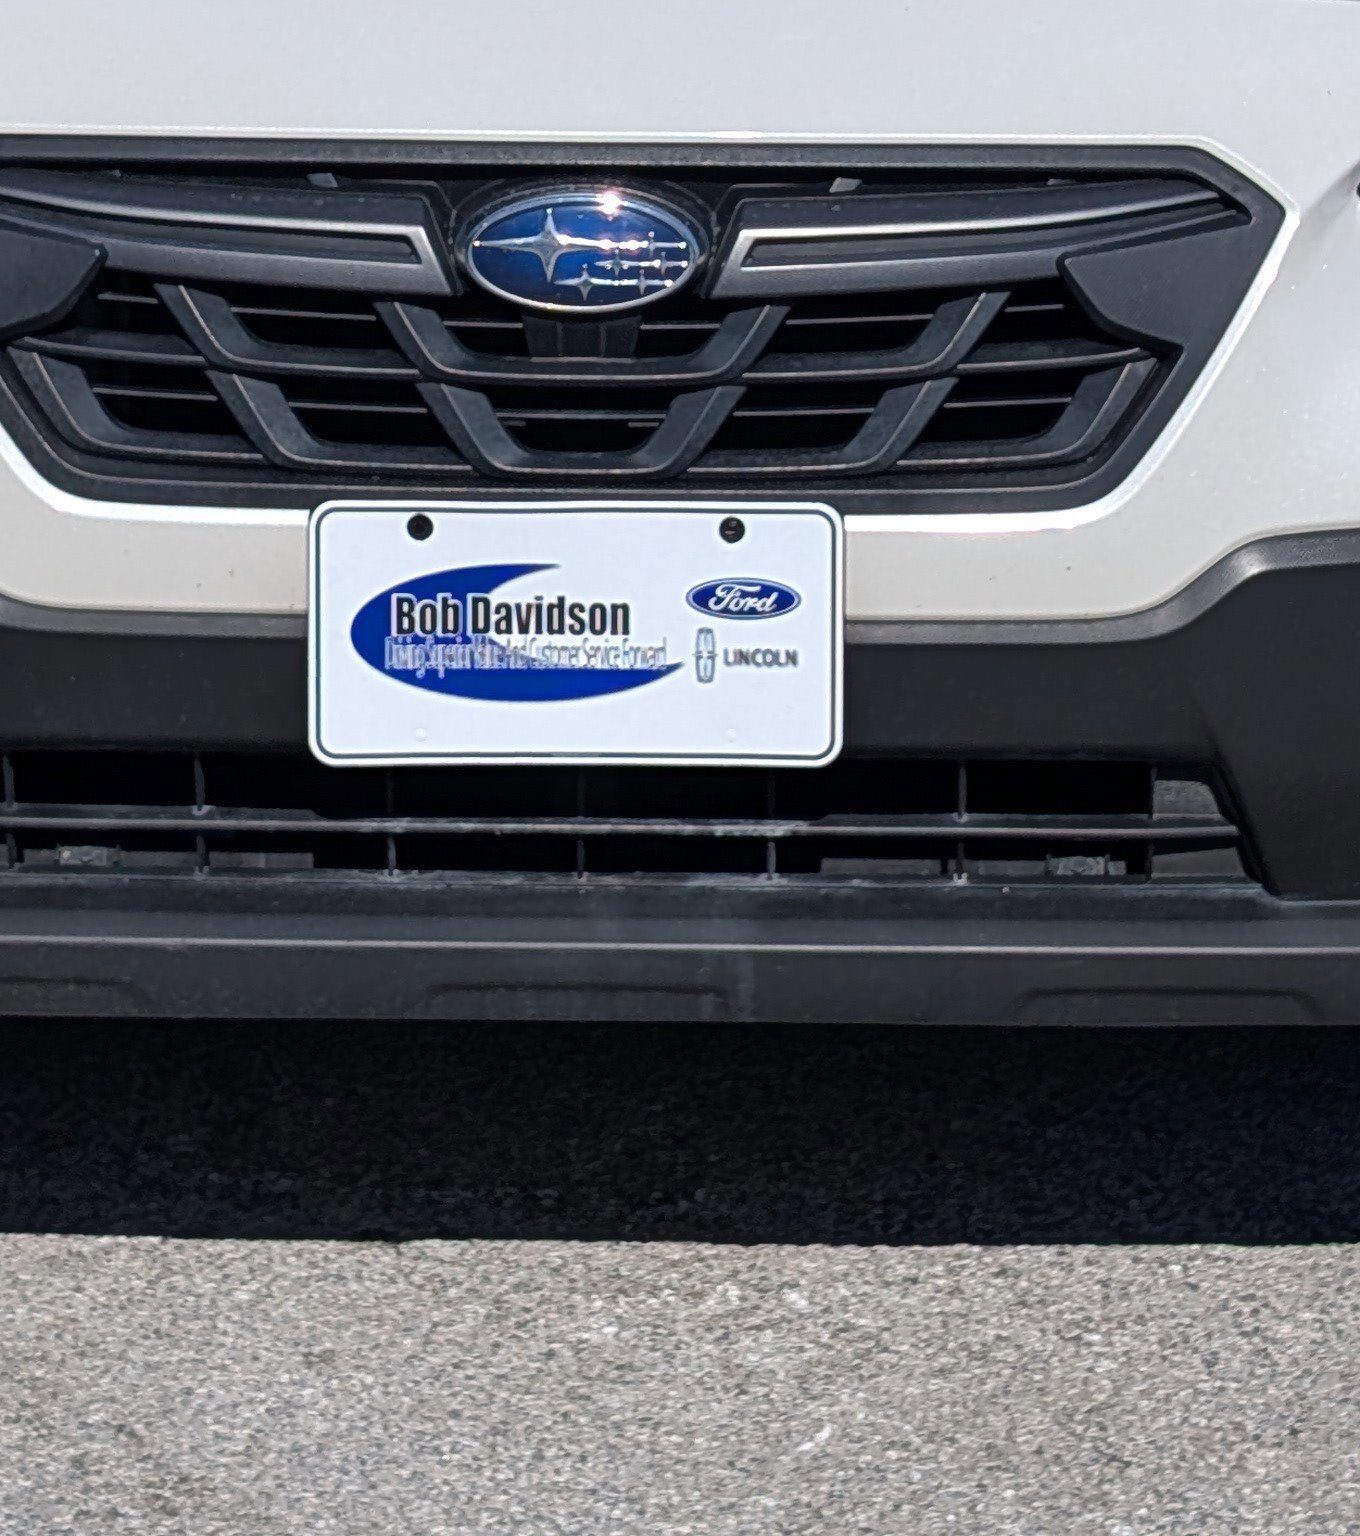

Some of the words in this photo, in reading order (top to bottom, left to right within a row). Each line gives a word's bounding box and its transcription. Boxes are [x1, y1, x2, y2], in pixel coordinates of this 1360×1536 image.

[708, 583, 779, 612] Ford
[395, 595, 461, 634] Bob
[471, 595, 629, 635] Davidson
[723, 647, 799, 668] LINCOLN
